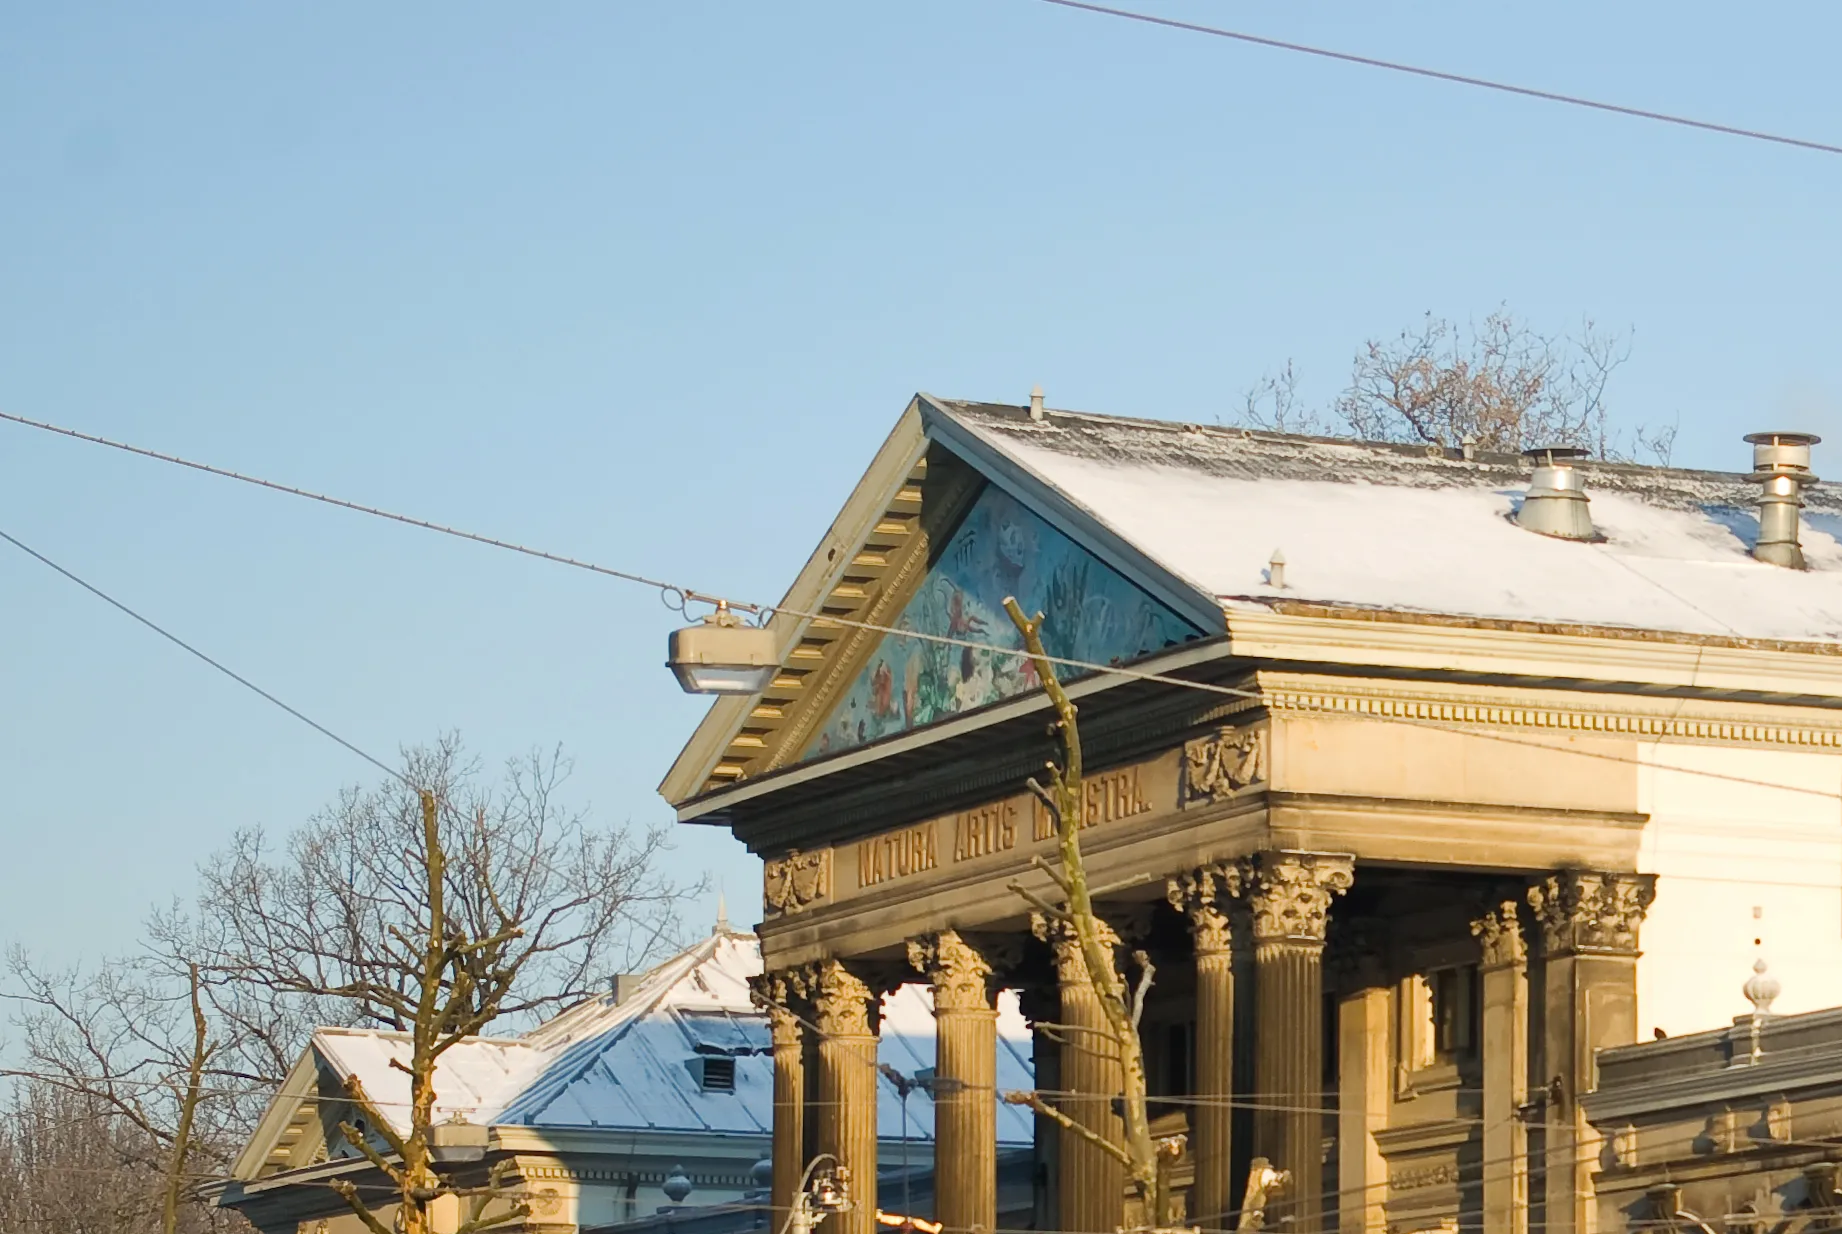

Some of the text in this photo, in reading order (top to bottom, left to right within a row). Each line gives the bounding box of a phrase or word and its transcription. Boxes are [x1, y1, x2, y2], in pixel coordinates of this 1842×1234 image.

[858, 766, 1153, 888] NATURA ARTIS MISTRA.
